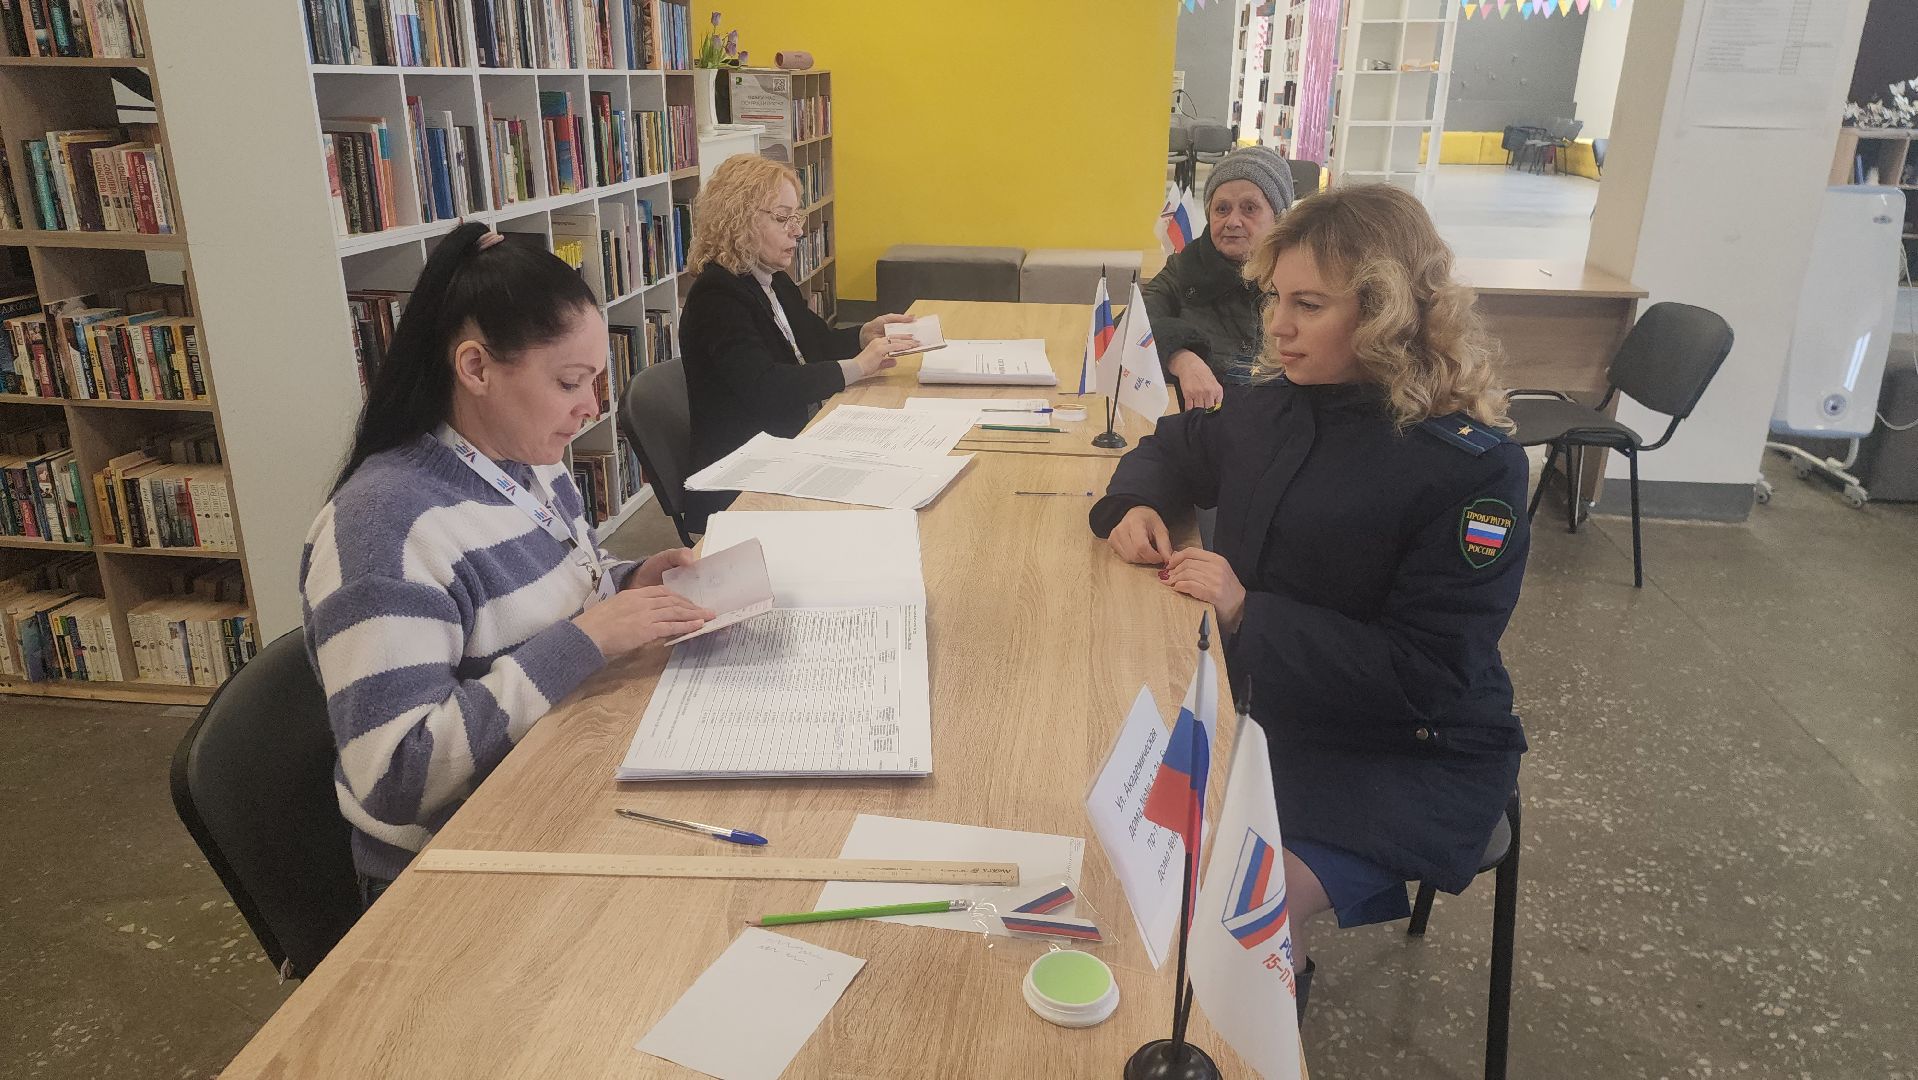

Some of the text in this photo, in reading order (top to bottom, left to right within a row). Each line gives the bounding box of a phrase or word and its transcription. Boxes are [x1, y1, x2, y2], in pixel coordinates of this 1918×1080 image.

[1466, 511, 1511, 528] ПРОКУРАТУРА
[1467, 543, 1497, 557] РОССИИ
[1124, 728, 1158, 798] Академическая
